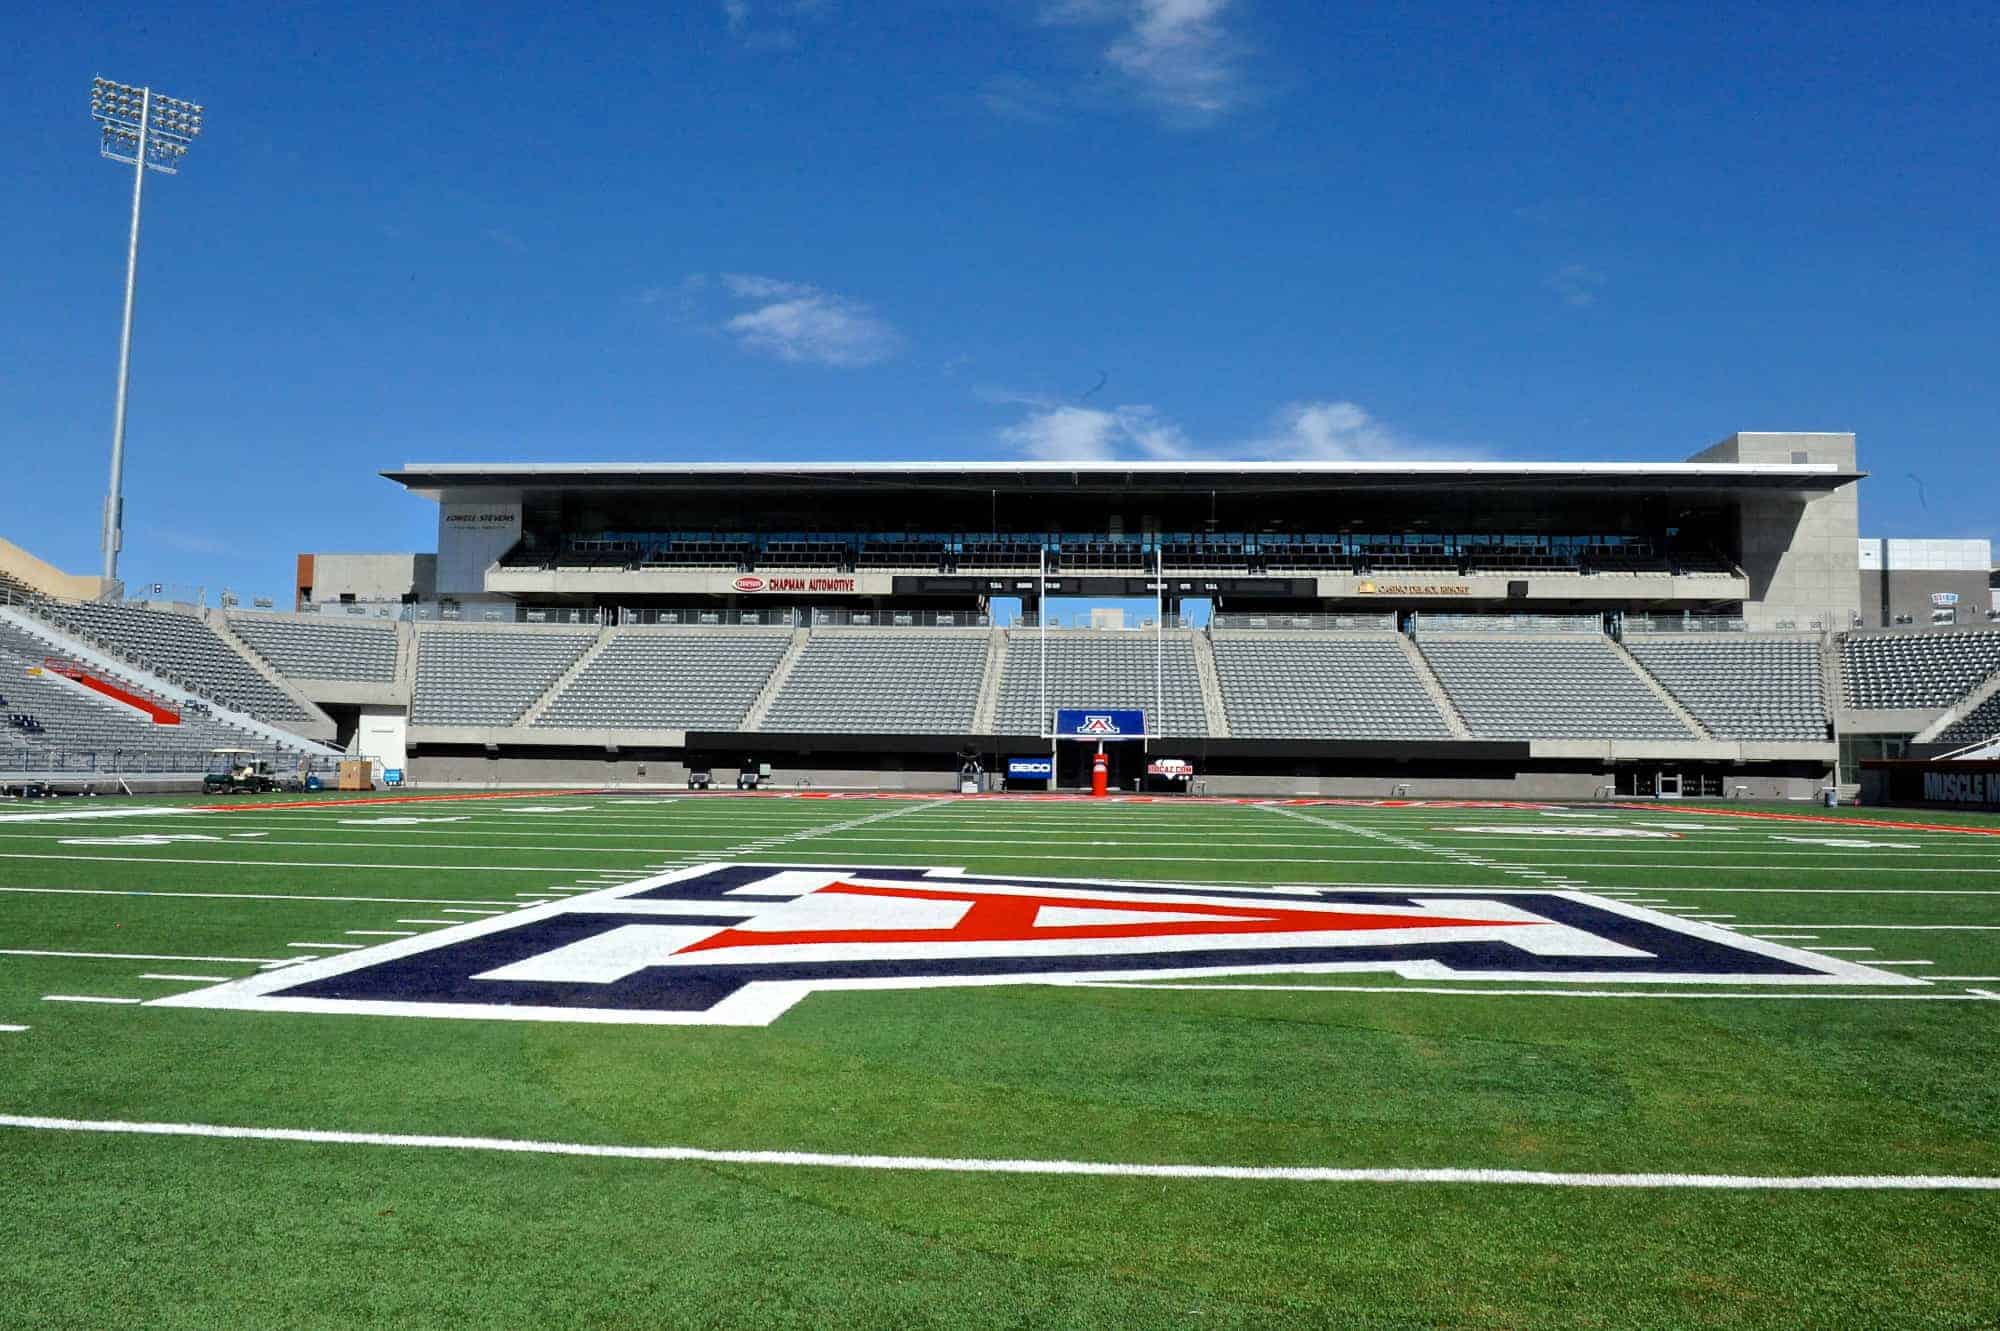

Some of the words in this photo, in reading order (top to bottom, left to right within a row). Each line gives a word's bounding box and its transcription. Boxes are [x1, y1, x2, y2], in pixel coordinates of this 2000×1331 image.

[769, 579, 804, 592] CHAPMAN
[809, 579, 854, 592] AUTOMOTIVE
[1923, 771, 1984, 802] MUSCLE
